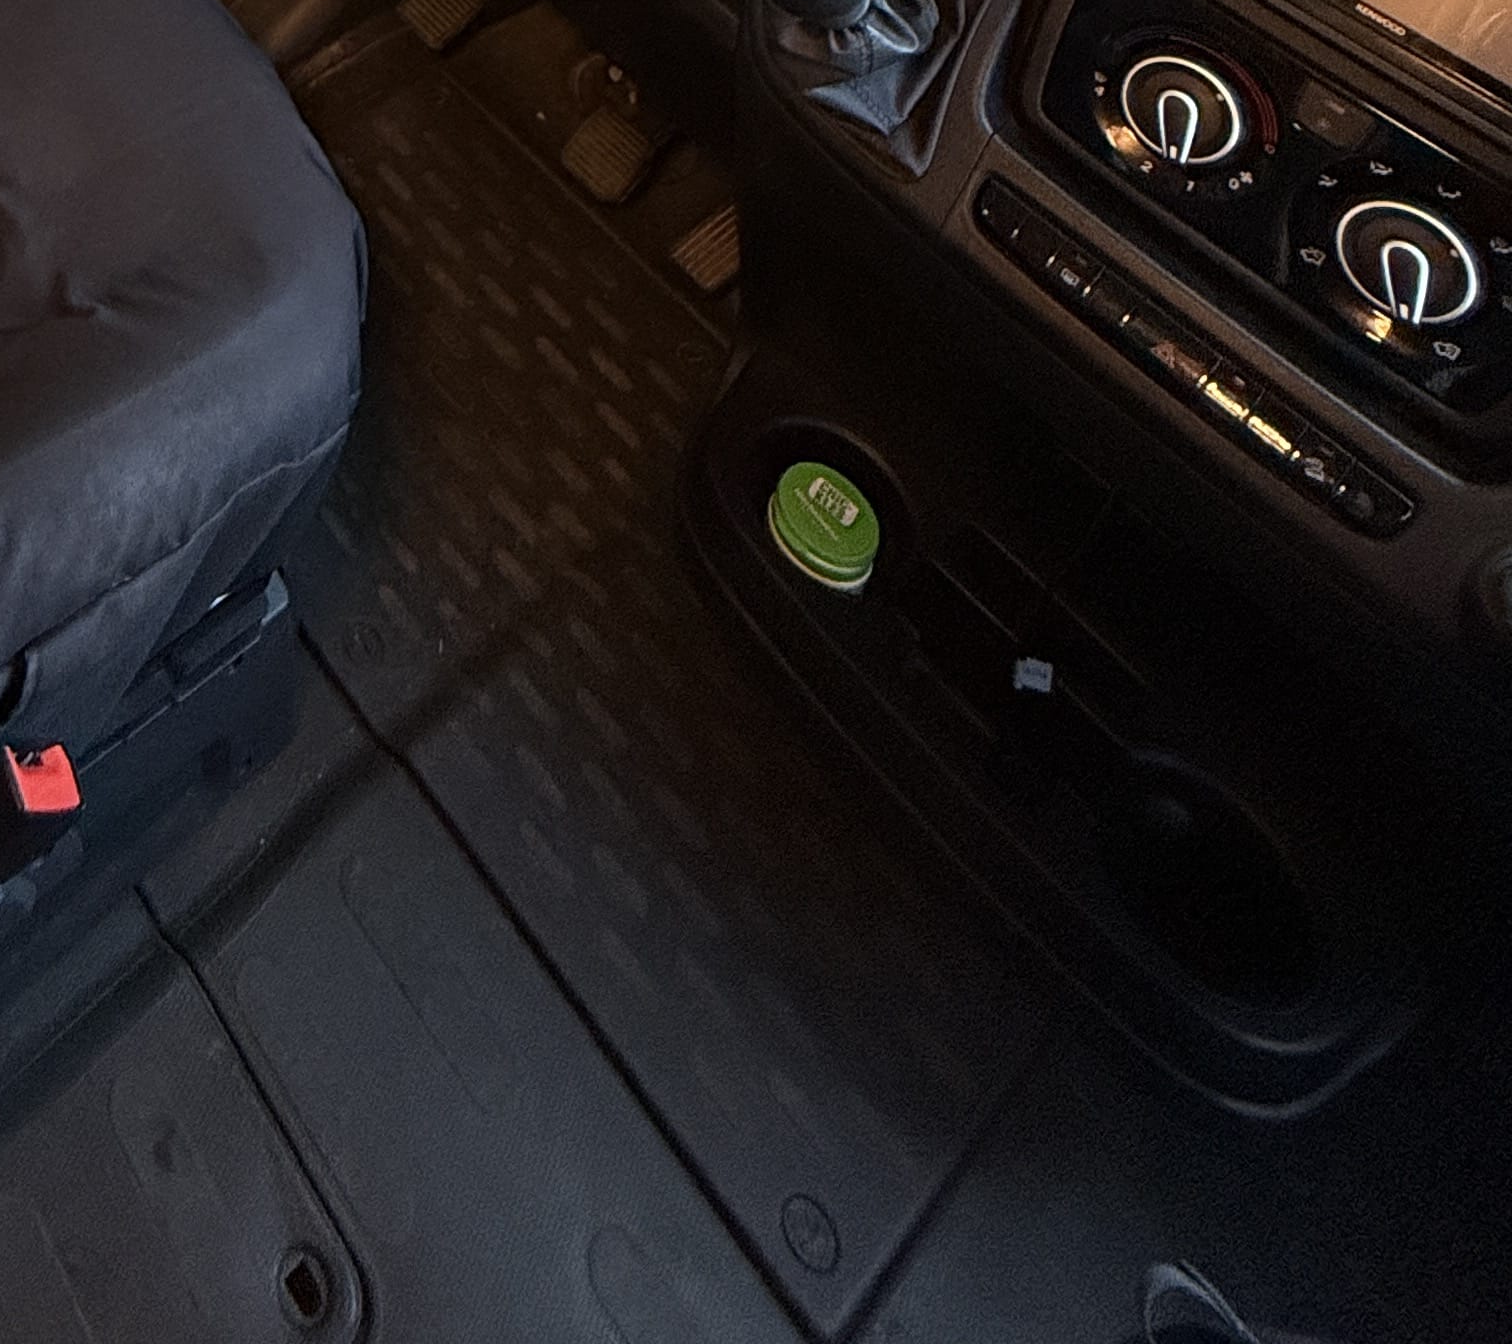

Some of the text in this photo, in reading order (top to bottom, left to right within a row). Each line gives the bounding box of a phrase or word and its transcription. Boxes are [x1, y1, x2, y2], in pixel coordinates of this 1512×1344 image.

[1355, 3, 1406, 36] KENWOOD
[1140, 160, 1153, 174] 2
[1186, 180, 1196, 192] 1
[1228, 177, 1240, 190] 0
